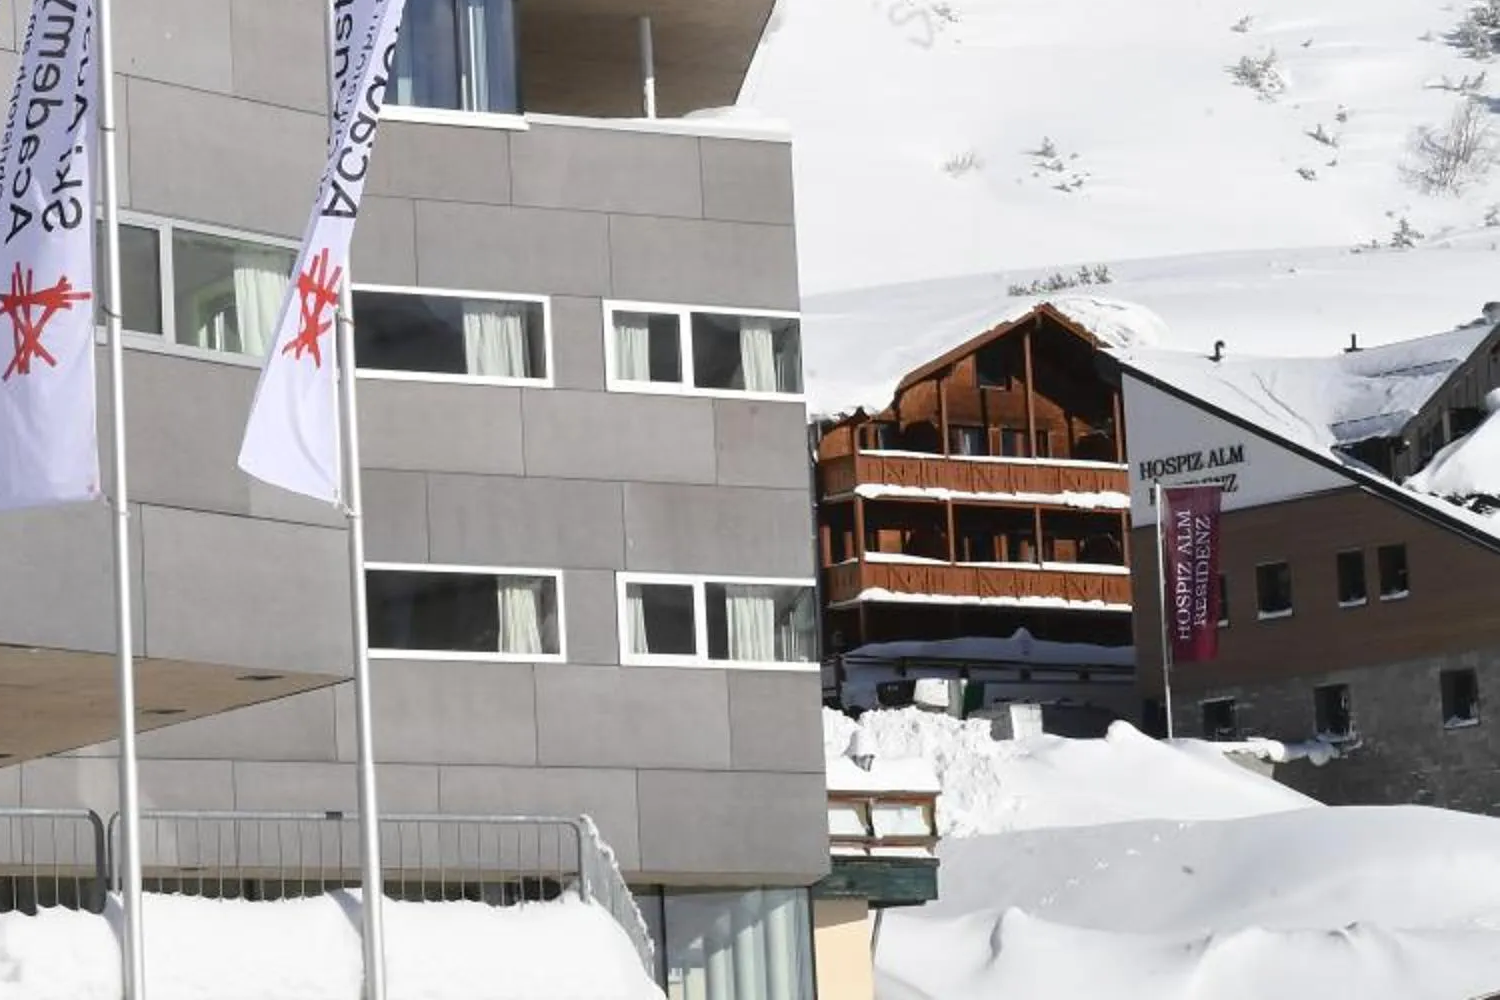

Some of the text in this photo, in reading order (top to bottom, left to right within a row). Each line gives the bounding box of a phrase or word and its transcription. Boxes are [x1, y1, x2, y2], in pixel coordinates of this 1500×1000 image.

[1140, 444, 1244, 480] HOSPIZ ALM
[1175, 509, 1192, 640] HOSPIZ ALM
[1194, 514, 1212, 627] RESIDENZ
